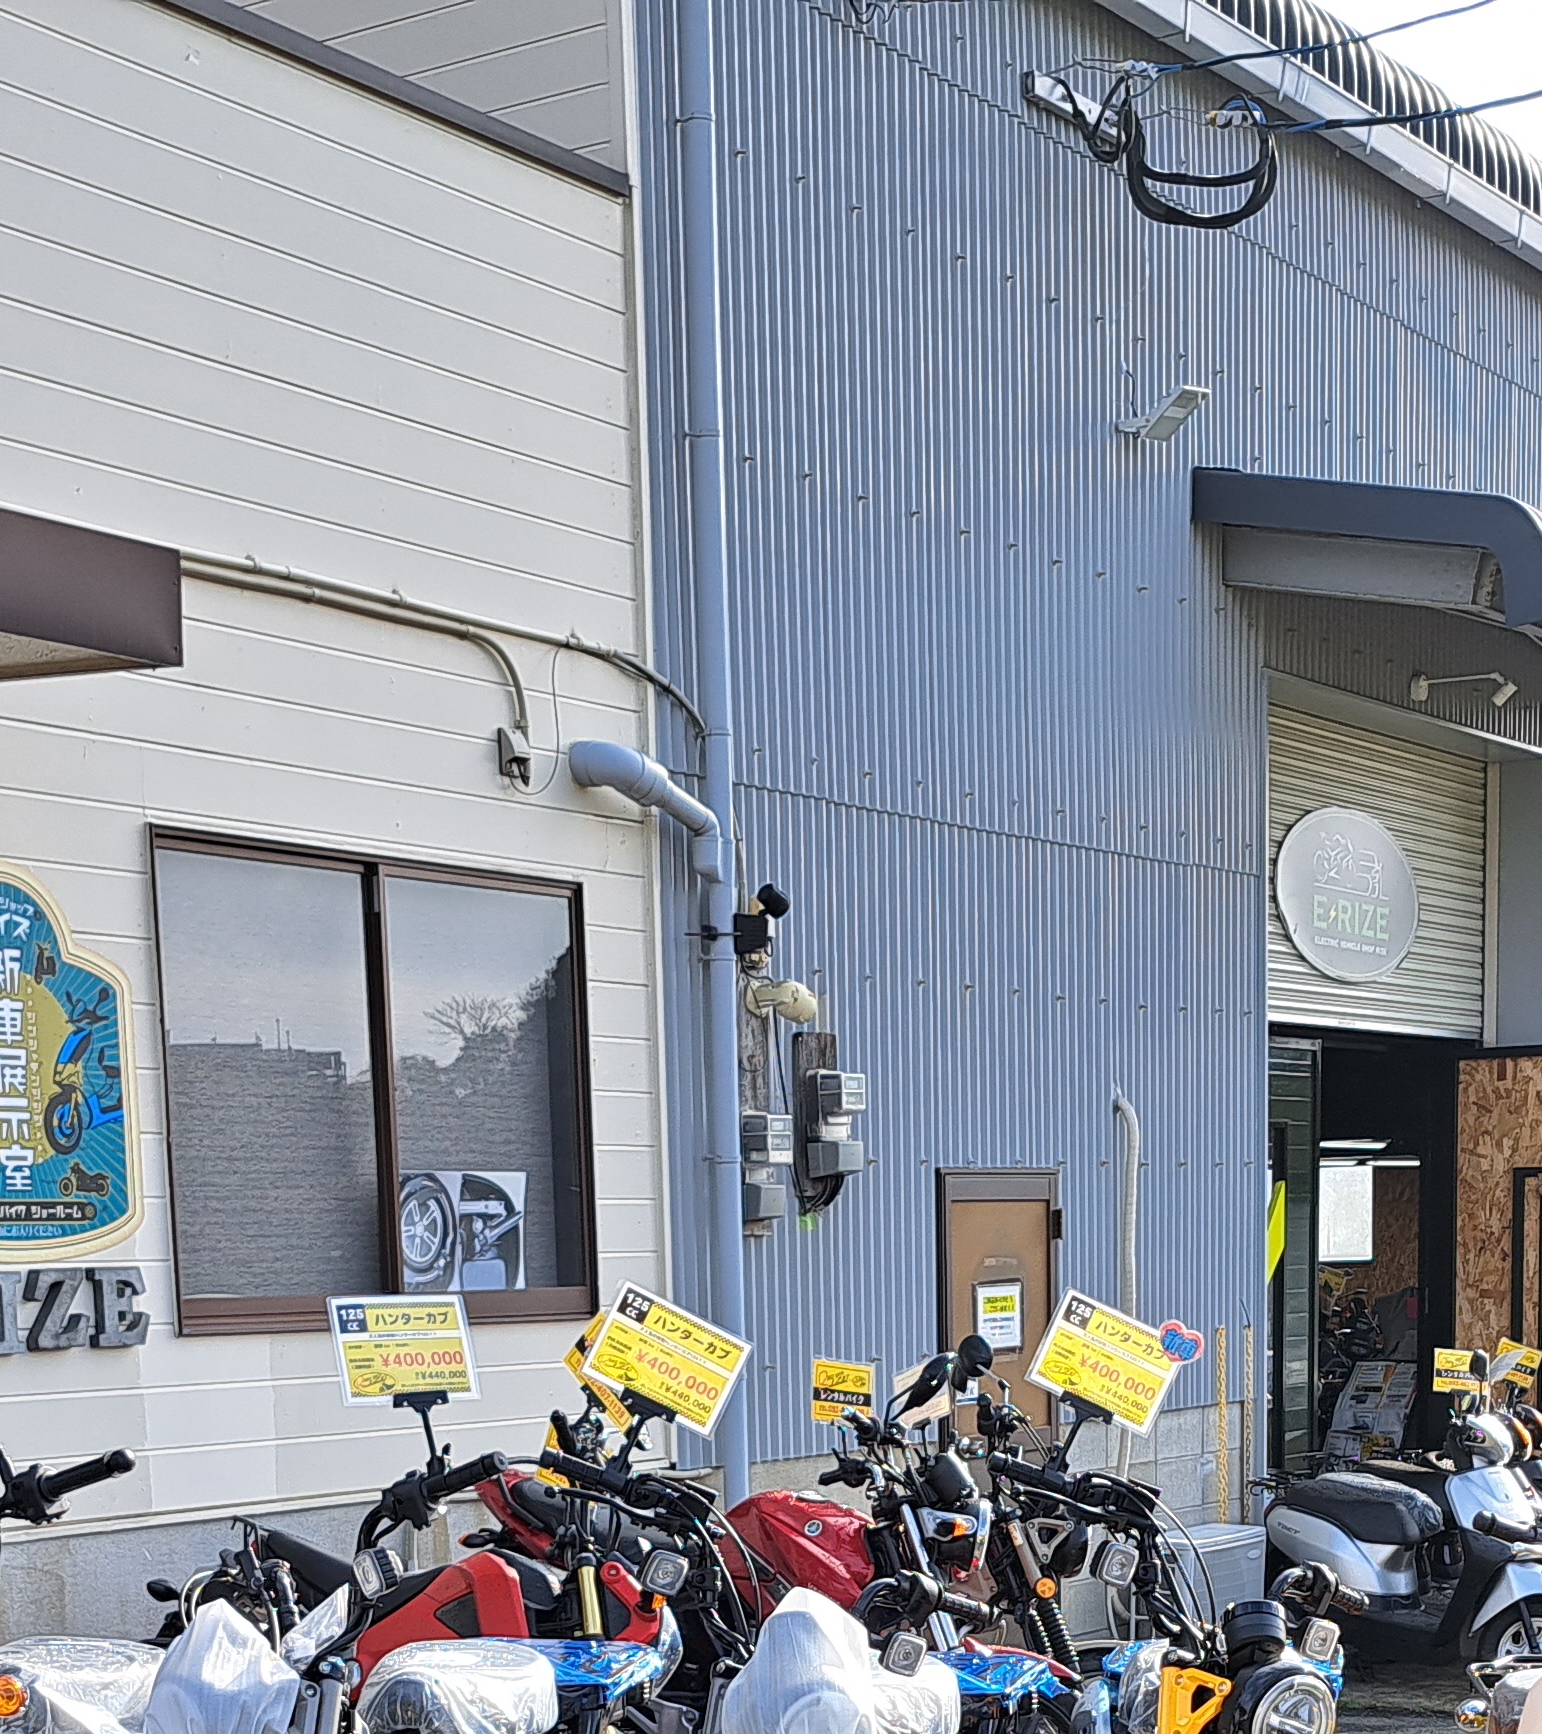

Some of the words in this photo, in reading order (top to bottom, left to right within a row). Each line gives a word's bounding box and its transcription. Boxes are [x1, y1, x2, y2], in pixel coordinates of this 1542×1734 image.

[30, 1204, 82, 1220] ショールーム
[625, 1292, 651, 1312] 125
[1070, 1299, 1093, 1318] 125
[339, 1308, 364, 1321] 125
[374, 1310, 449, 1327] ハンターカブ
[624, 1308, 640, 1320] CC
[347, 1322, 361, 1331] CC
[652, 1314, 733, 1361] ハンターカブ
[1161, 1328, 1198, 1361] 新車
[379, 1350, 464, 1369] ¥400,000
[634, 1348, 720, 1401] ¥400,000
[1078, 1352, 1157, 1402] ¥400,000
